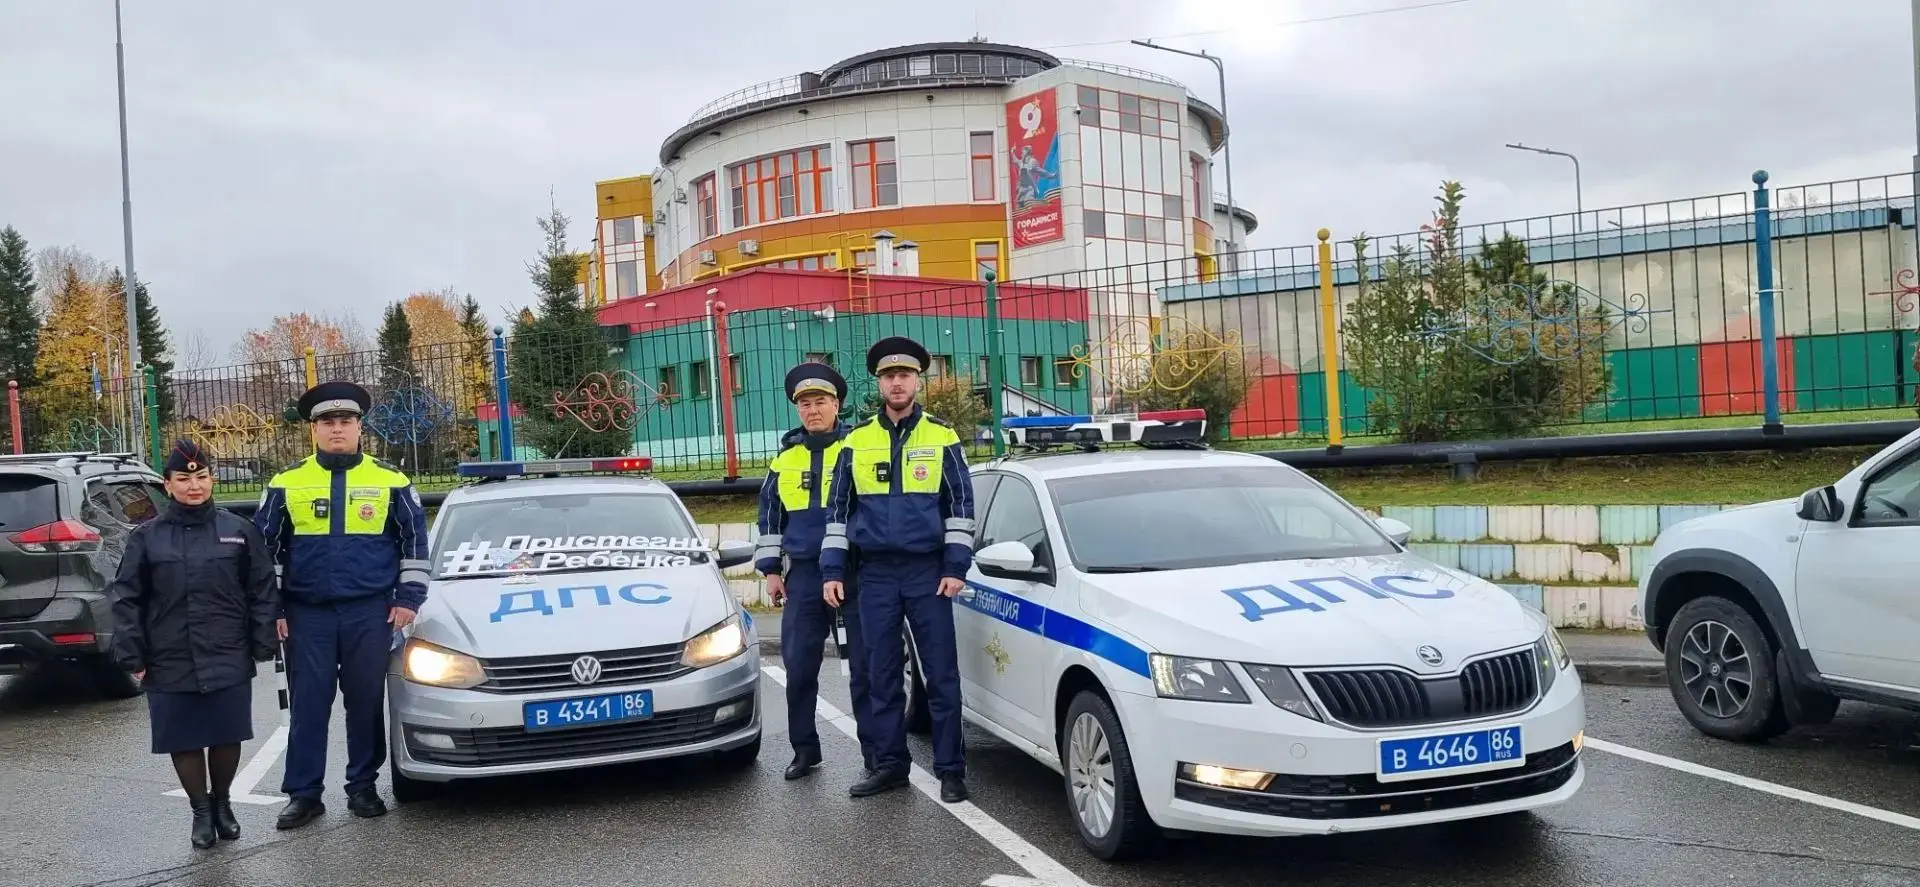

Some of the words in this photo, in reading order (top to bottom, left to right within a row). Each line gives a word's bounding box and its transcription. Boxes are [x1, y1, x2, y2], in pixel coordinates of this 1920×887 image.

[1018, 102, 1042, 139] 9
[502, 535, 710, 554] Пристегни
[540, 551, 692, 569] Ребенка
[490, 583, 672, 623] ДПС
[976, 589, 1020, 621] ПОЛИЦИЯ
[1220, 575, 1455, 622] ДПС
[536, 709, 548, 725] В
[558, 698, 611, 722] 4341
[624, 693, 645, 710] 86
[627, 709, 643, 717] RUS
[1393, 749, 1407, 769] В
[1418, 735, 1478, 766] 4646
[1492, 729, 1514, 750] 86
[1495, 749, 1512, 759] RUS
